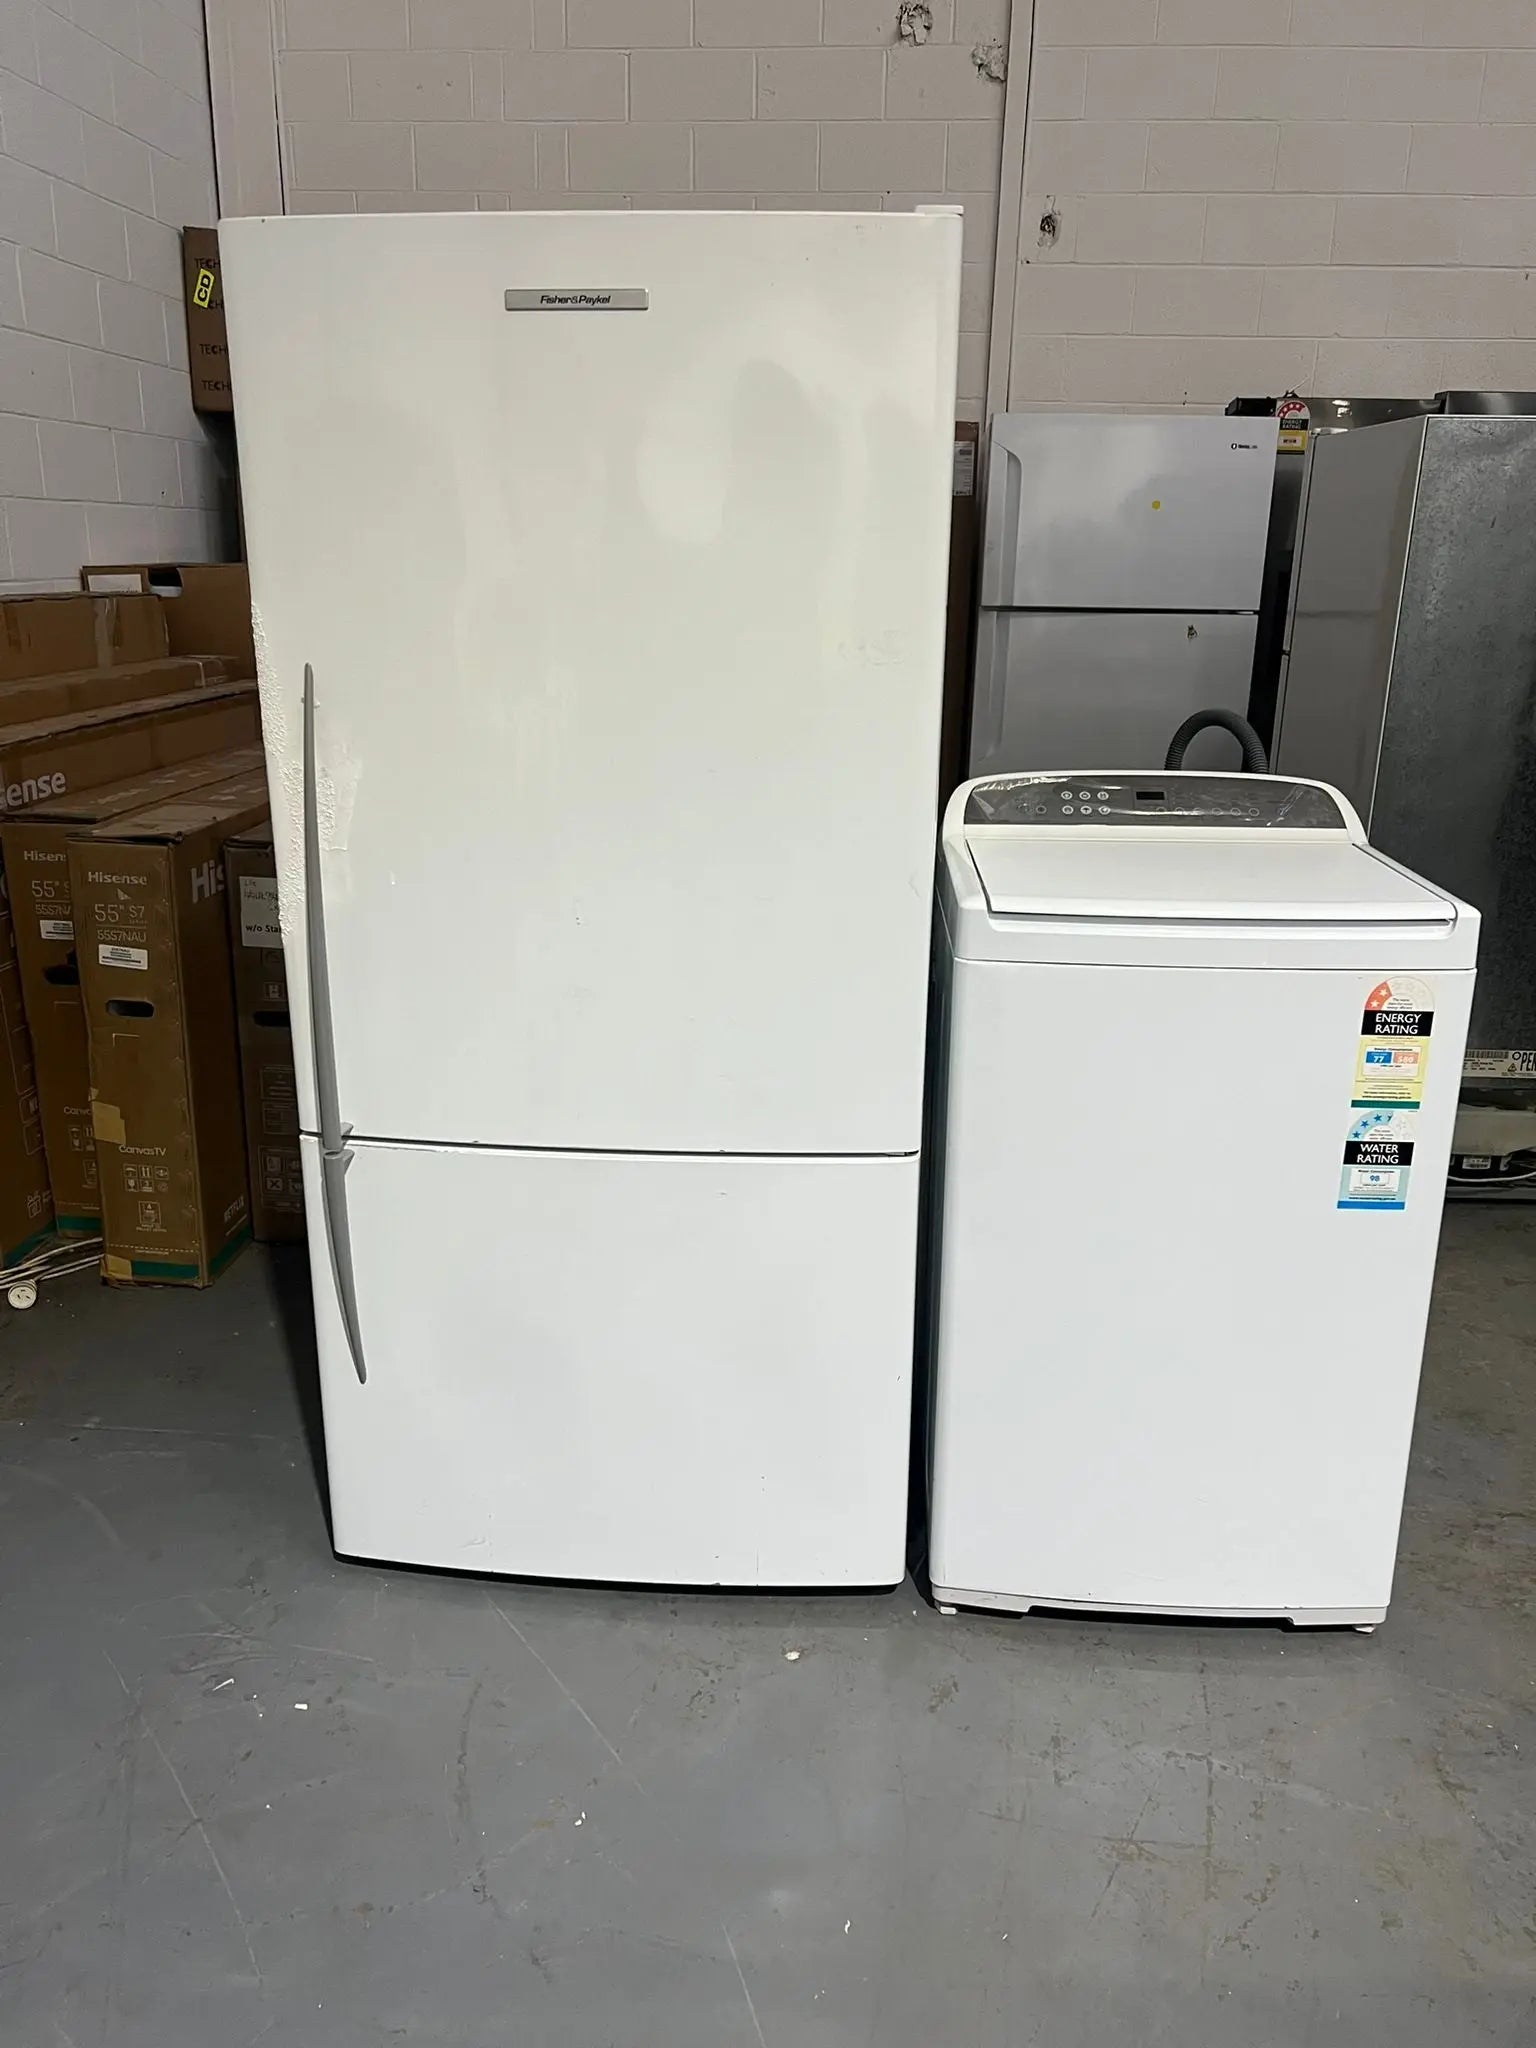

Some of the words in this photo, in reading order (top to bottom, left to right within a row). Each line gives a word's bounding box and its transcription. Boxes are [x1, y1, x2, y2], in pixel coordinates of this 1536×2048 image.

[197, 273, 211, 302] CD
[540, 295, 611, 306] Fisher&Paykel
[88, 871, 147, 885] Hisense
[94, 903, 125, 922] 55"
[128, 905, 145, 918] S7
[97, 929, 147, 943] 55S7NAU
[1375, 1013, 1421, 1023] ENERGY
[1375, 1024, 1418, 1034] RATING
[1373, 1055, 1384, 1063] 77
[119, 1144, 167, 1157] CanvasTV
[1360, 1143, 1399, 1153] WATER
[1357, 1154, 1399, 1164] RATING
